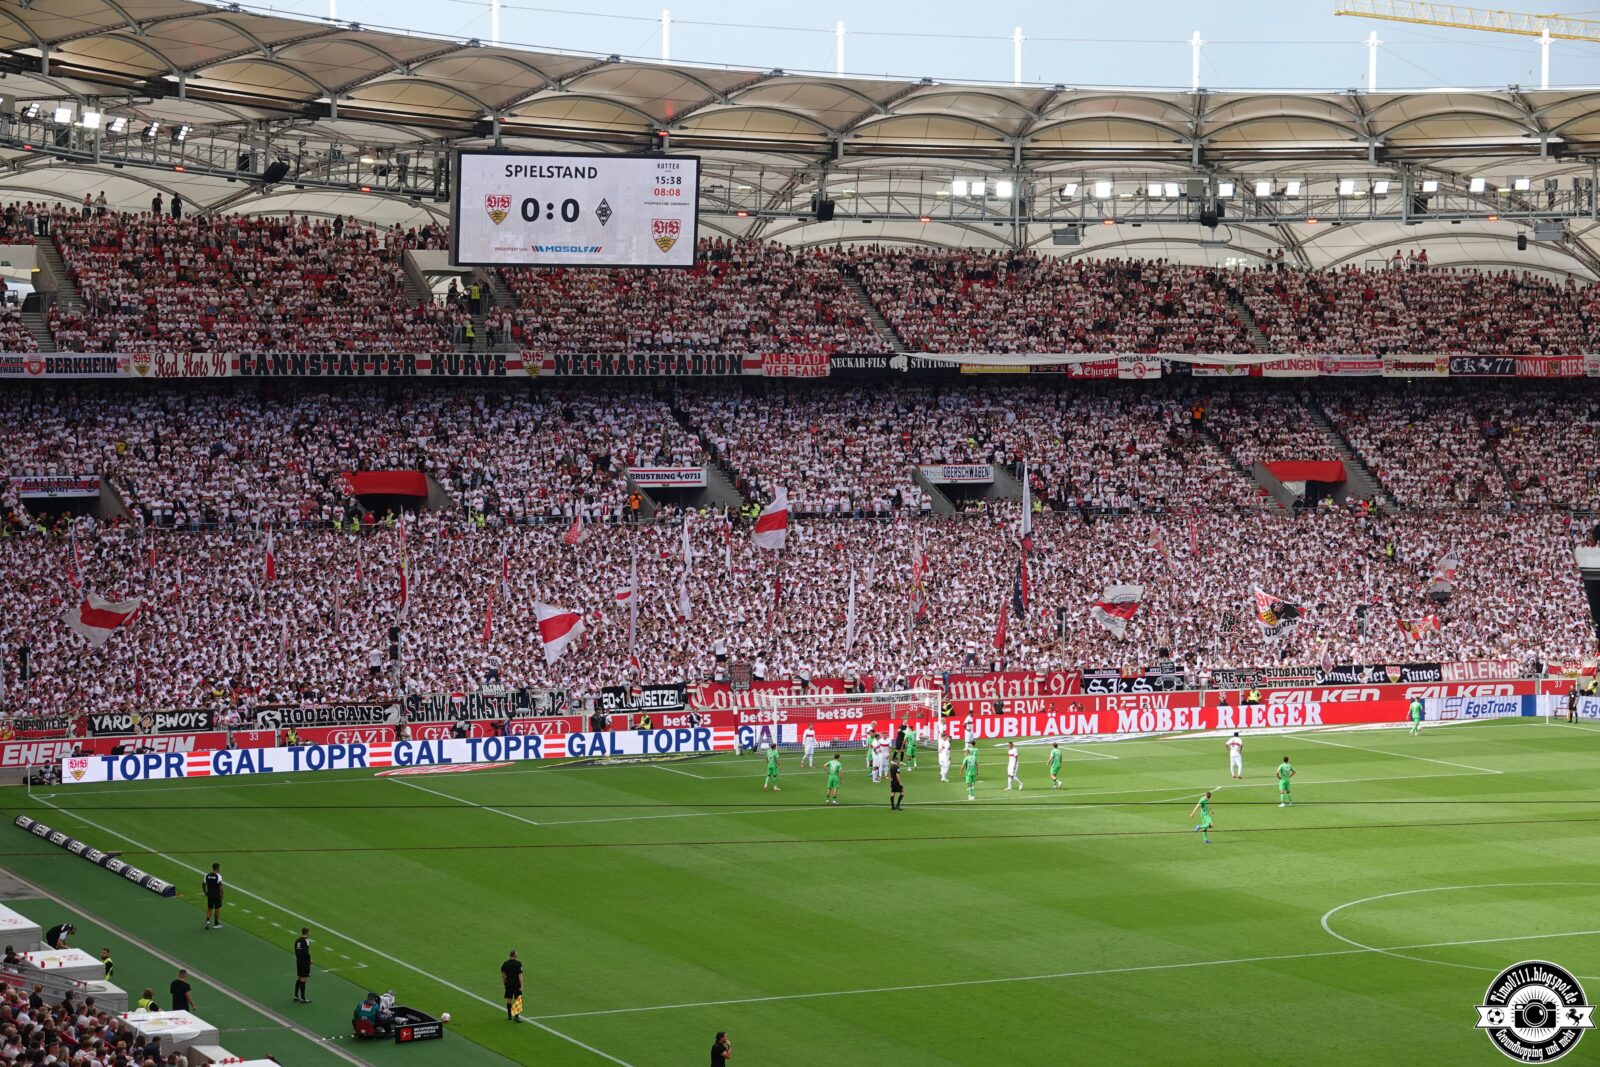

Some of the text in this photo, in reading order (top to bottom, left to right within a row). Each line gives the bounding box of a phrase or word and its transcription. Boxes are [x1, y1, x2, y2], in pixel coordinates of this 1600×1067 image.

[505, 164, 598, 179] SPIELSTAND
[655, 176, 682, 185] 15:38
[654, 188, 681, 197] 08:08
[521, 198, 580, 223] 0:0
[45, 357, 117, 374] BERKHEIM
[155, 352, 227, 377] Red Hots 96
[239, 354, 507, 377] CANNSTATTER KURVE
[554, 354, 743, 377] NECKARSTADION
[764, 353, 829, 364] ALBSTADT
[831, 357, 886, 369] NECKAR-FILS
[1265, 358, 1317, 371] GERLINGEN
[1495, 358, 1515, 373] 77
[766, 365, 827, 377] VFB-FANS
[1516, 360, 1548, 377] DONAU
[1561, 359, 1584, 375] RIES
[631, 472, 701, 480] BRUSTRING 0711
[943, 468, 990, 480] OBERSCHWABEN
[1213, 671, 1247, 684] CREW
[1268, 680, 1316, 688] STUTTGART
[1402, 667, 1441, 684] Jungs
[1050, 672, 1078, 697] 97
[1404, 684, 1515, 702] FALKEN
[1554, 682, 1563, 691] 37
[602, 692, 626, 709] 50+1
[1268, 688, 1381, 705] FALKEN
[279, 706, 384, 724] HOOLIGANS
[816, 707, 864, 720] bet365
[1465, 700, 1518, 718] EgeTrans
[1583, 700, 1600, 717] Eg
[92, 711, 208, 730] YARD BWOYS
[971, 712, 1099, 738] JUBILÄUM
[1117, 702, 1323, 733] MÖBEL RIEGER
[249, 732, 259, 744] 33
[424, 726, 478, 741] GAI
[2, 744, 83, 766] EHEIM
